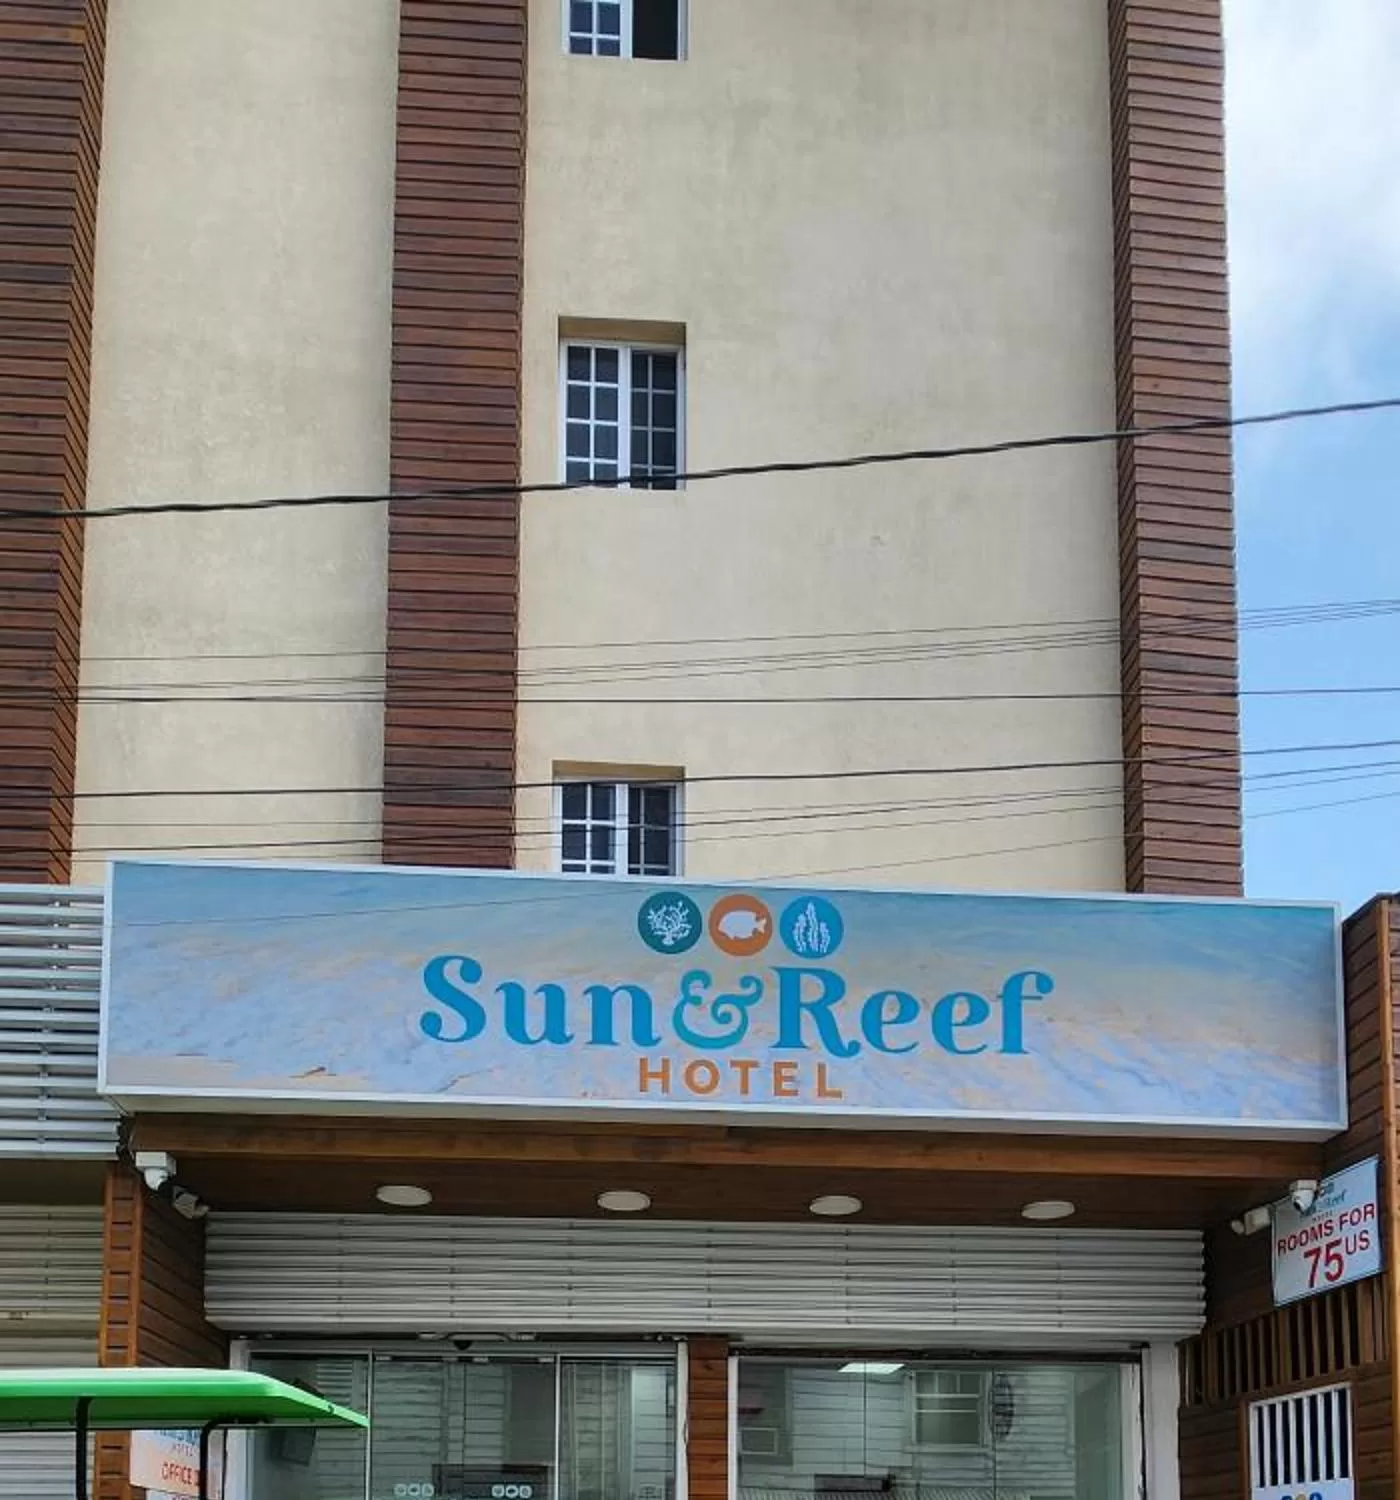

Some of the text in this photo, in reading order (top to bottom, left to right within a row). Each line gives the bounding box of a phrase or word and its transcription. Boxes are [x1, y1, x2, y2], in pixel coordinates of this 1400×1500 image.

[420, 954, 1053, 1058] Sun&Reef
[639, 1057, 843, 1099] HOTEL
[1277, 1203, 1375, 1256] ROOMS FOR
[1303, 1230, 1370, 1288] 75 US
[162, 1461, 193, 1485] OFFICE
